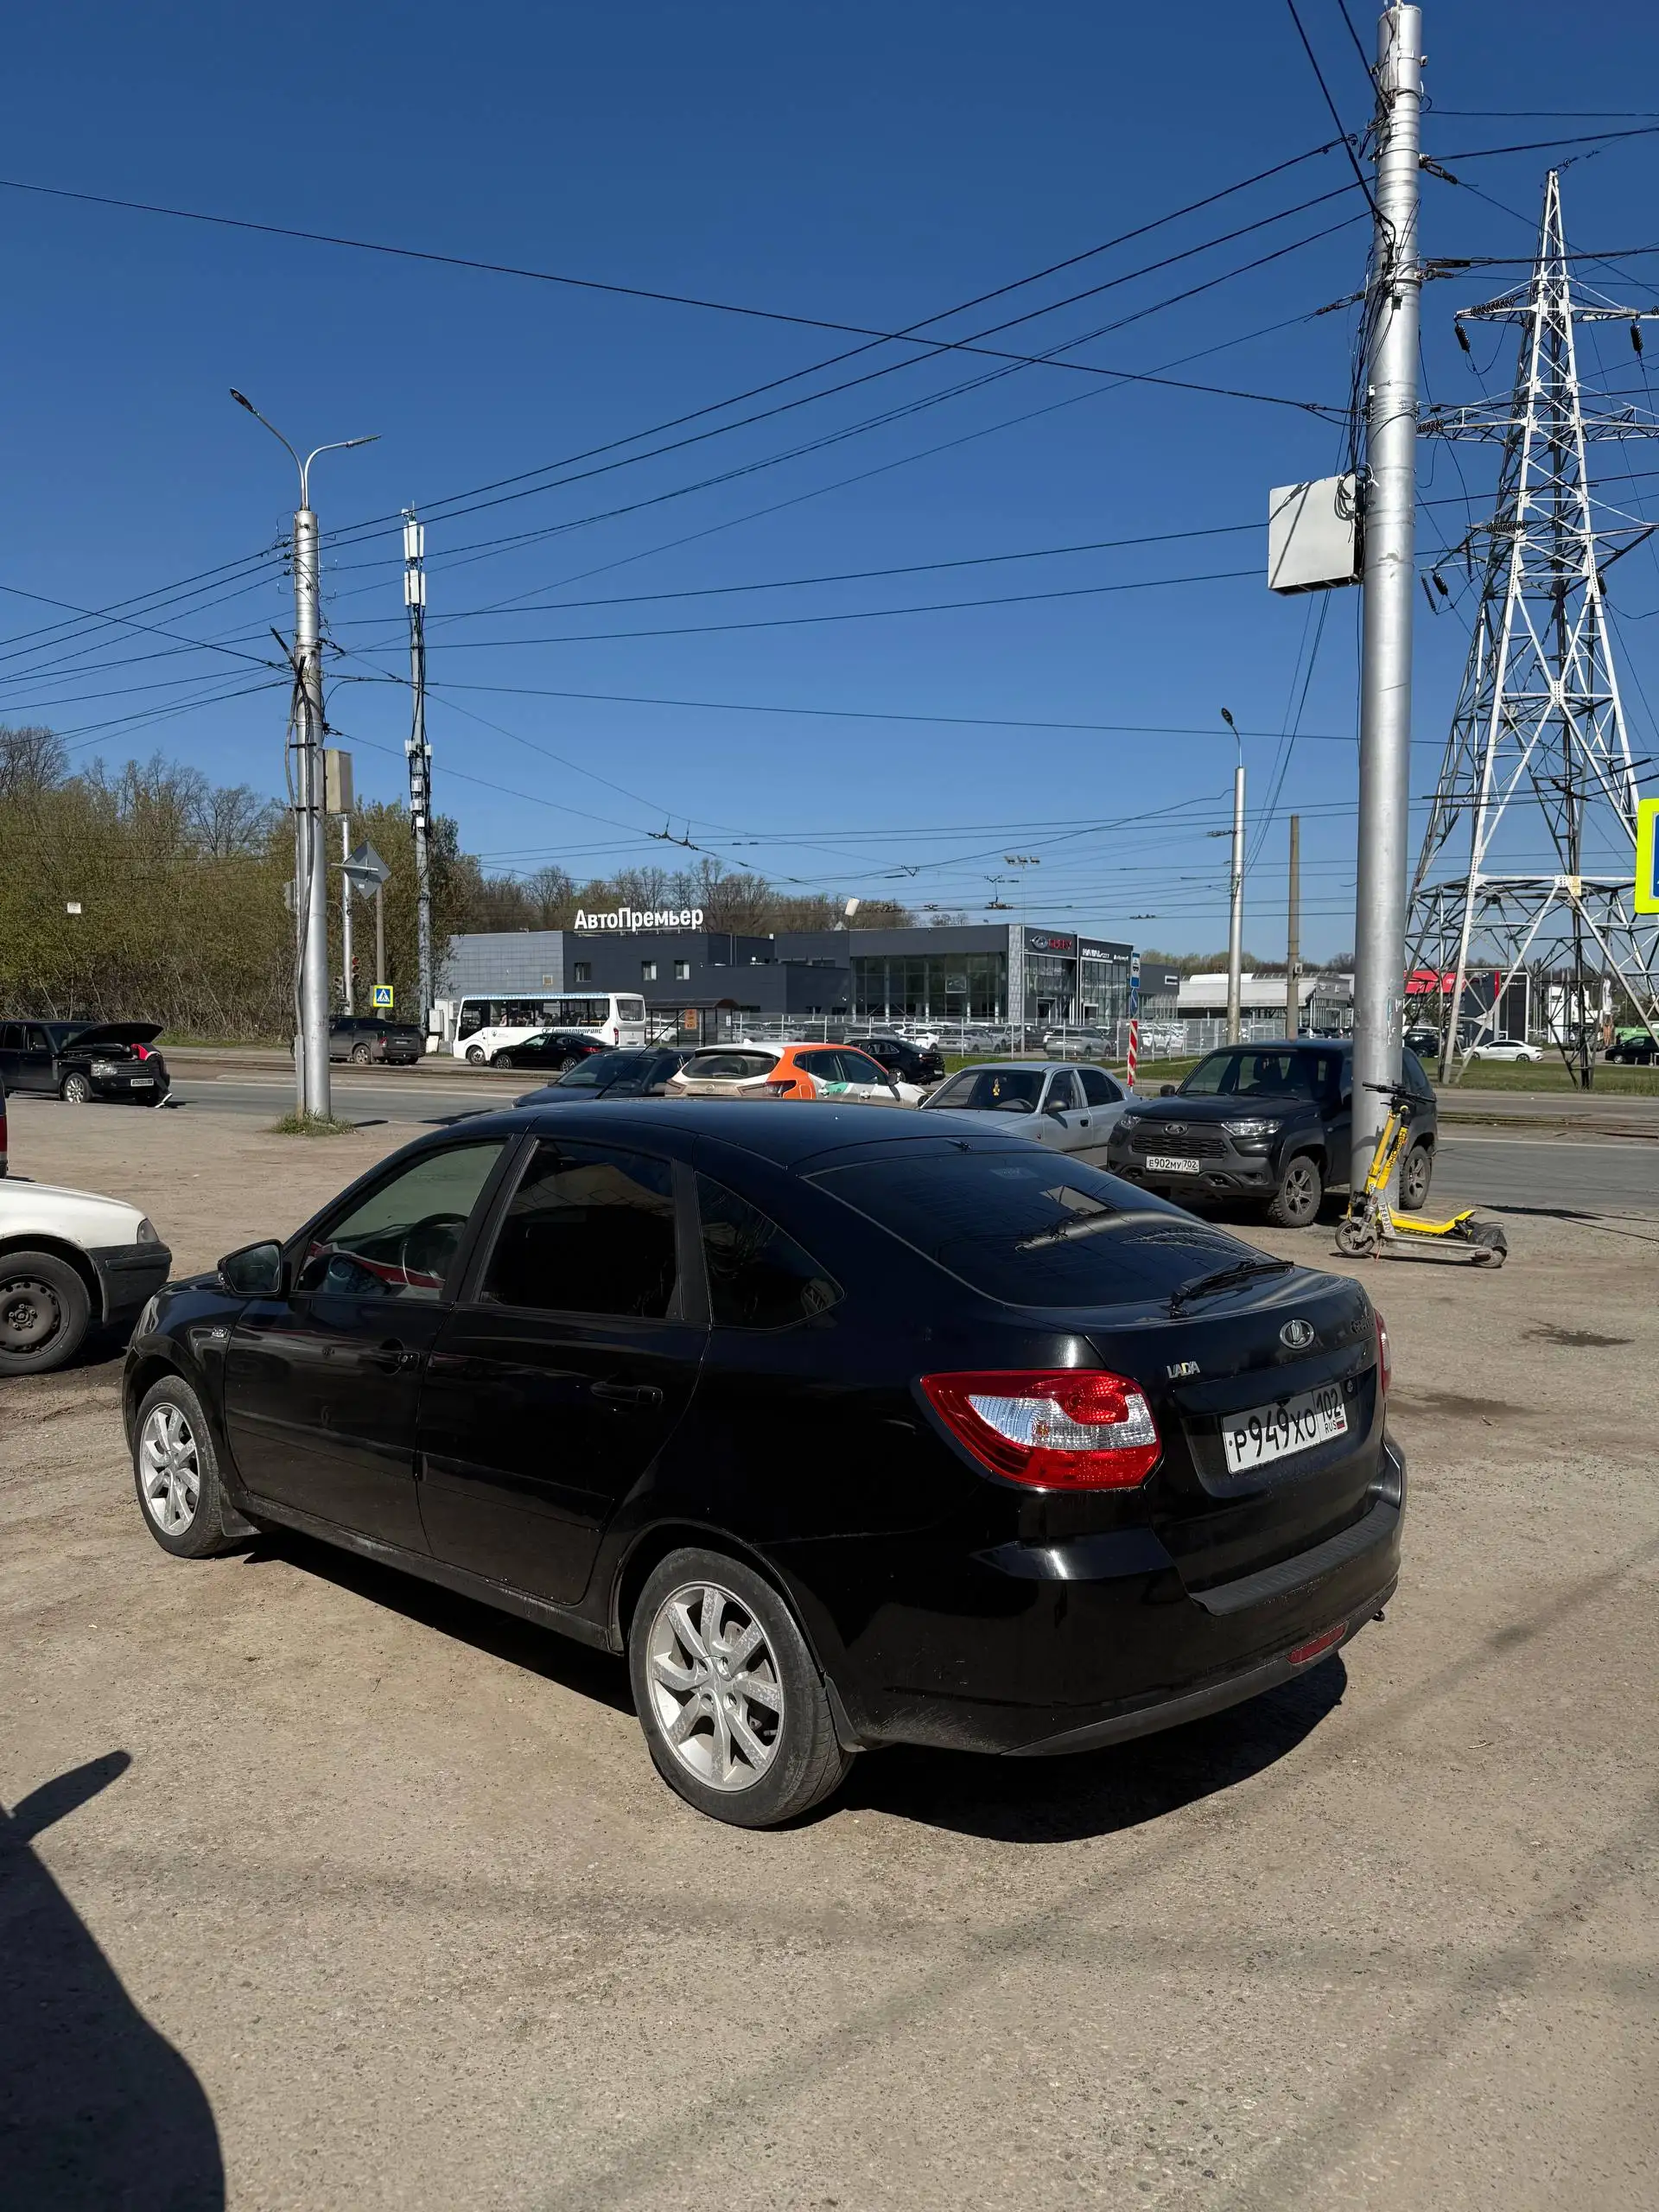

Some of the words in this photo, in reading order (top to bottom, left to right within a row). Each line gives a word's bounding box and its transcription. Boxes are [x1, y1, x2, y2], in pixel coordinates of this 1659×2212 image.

[574, 907, 703, 931] АвтоПремьер
[1149, 1158, 1181, 1169] Е902МУ
[1183, 1160, 1197, 1168] 702
[1166, 1361, 1200, 1378] LADA
[1234, 1408, 1316, 1463] Р949ХО
[1317, 1388, 1341, 1422] 102
[1325, 1420, 1337, 1433] RUS
